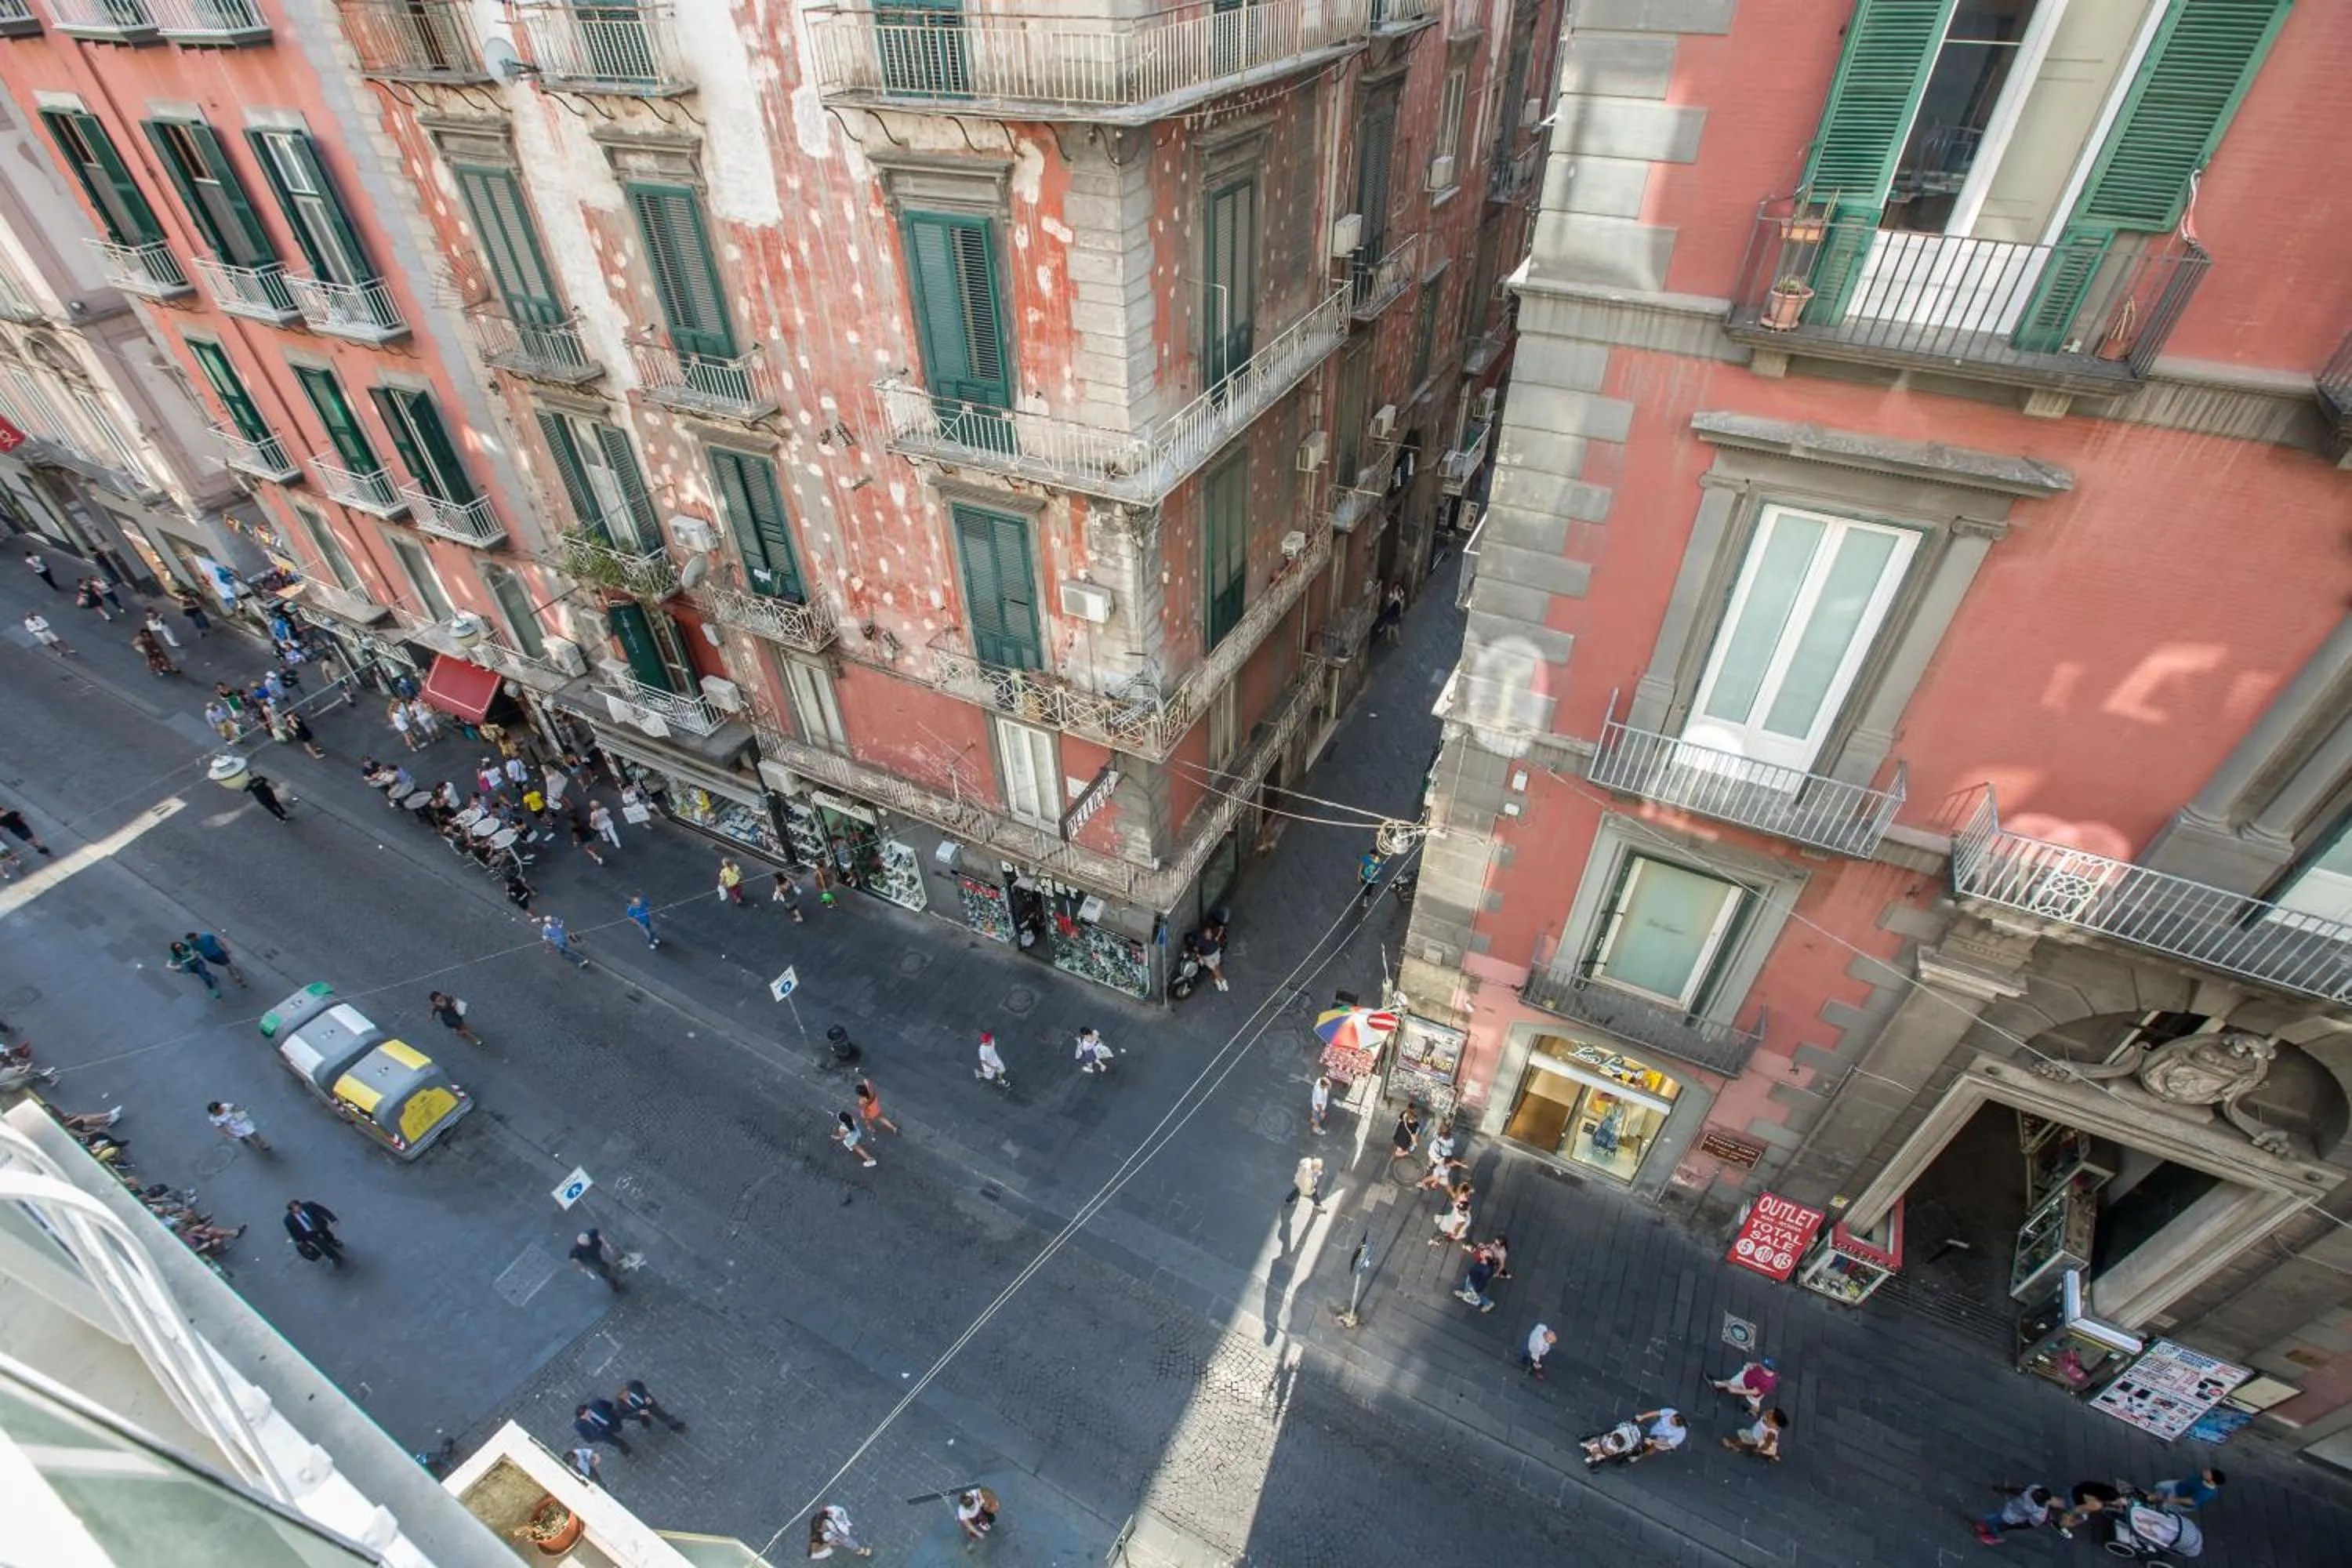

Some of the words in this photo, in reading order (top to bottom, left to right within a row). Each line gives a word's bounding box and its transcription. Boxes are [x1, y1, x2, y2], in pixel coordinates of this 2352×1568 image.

[1759, 1196, 1820, 1229] OUTLET
[1749, 1230, 1796, 1253] SALE
[1752, 1218, 1803, 1246] TOTAL
